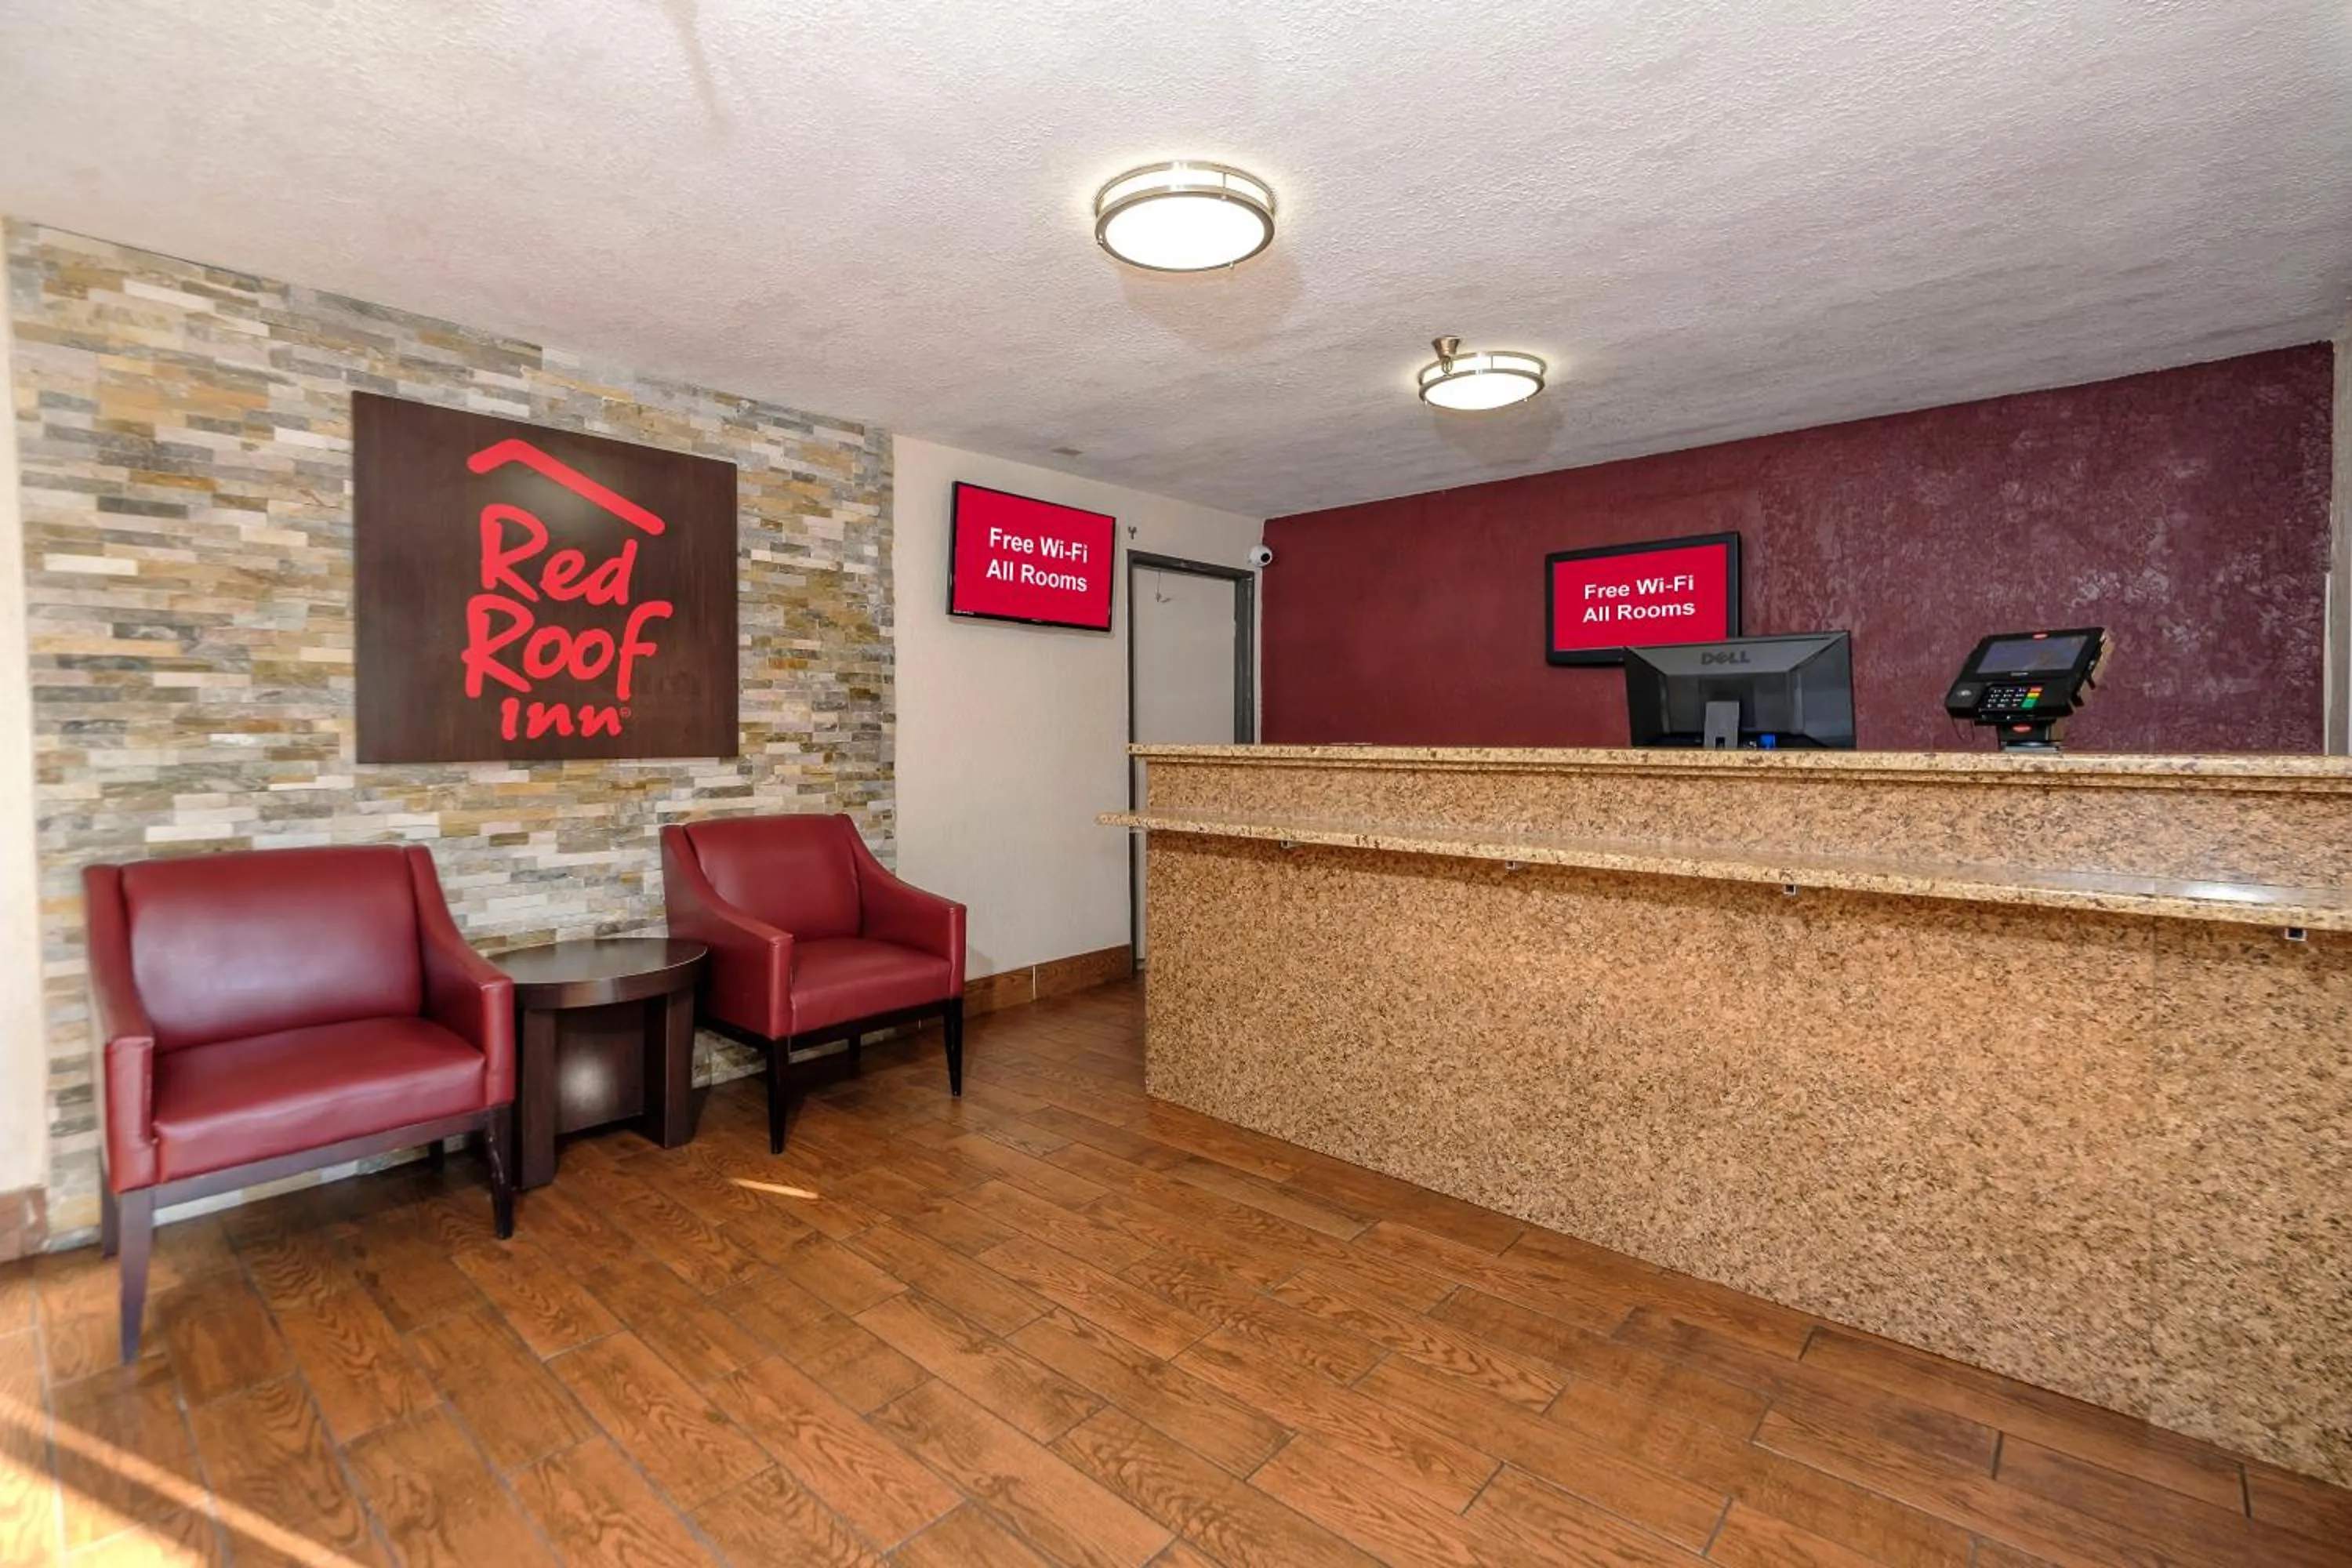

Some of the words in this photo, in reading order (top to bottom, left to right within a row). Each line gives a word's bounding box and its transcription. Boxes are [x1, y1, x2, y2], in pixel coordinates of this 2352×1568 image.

[481, 504, 637, 604] Red
[990, 528, 1034, 553] Free
[1040, 537, 1087, 563] Wi-Fi
[986, 559, 1014, 581] All
[1021, 564, 1087, 592] Rooms
[1584, 584, 1630, 600] Free
[1636, 575, 1694, 594] Wi-Fi
[1583, 605, 1610, 623] All
[1617, 602, 1696, 619] Rooms
[462, 594, 673, 701] Roof
[1700, 651, 1751, 665] DELL
